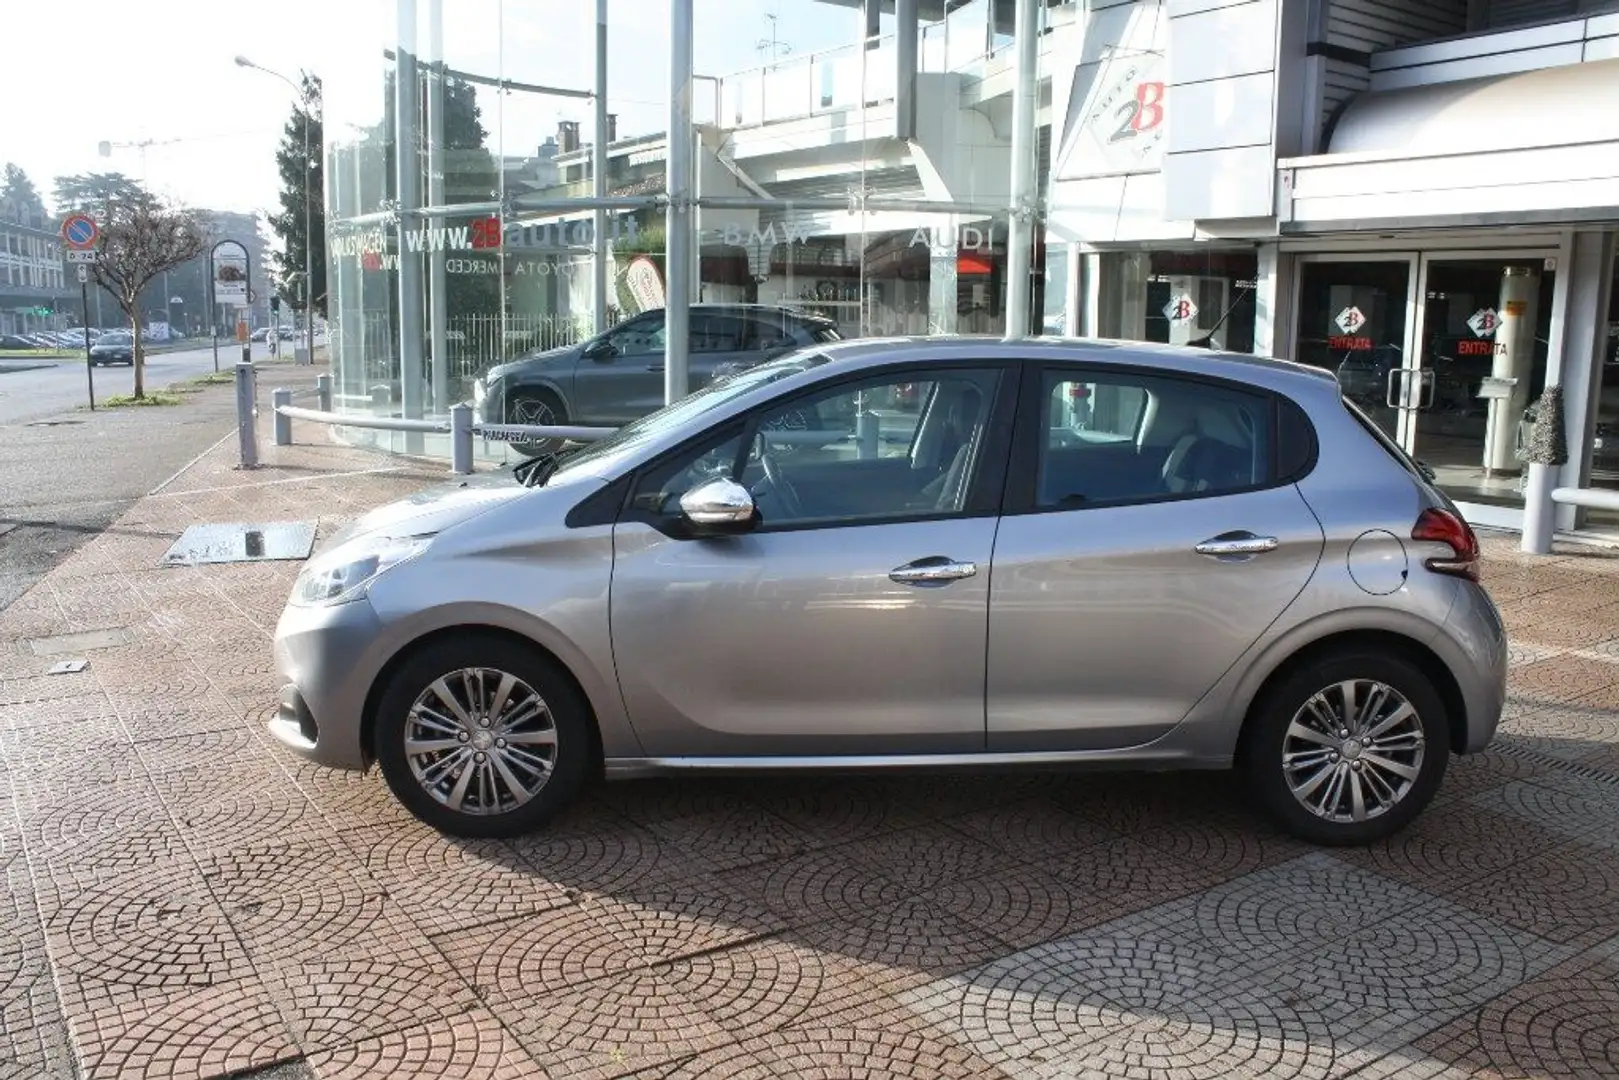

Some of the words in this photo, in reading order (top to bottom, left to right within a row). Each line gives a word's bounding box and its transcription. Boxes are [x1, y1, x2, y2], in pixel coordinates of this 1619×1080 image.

[1106, 81, 1165, 145] 2B
[724, 220, 811, 246] BMW
[908, 224, 993, 250] AUDI
[1171, 298, 1190, 320] 2B
[1343, 312, 1359, 327] 2B
[1477, 313, 1495, 331] 2B
[1328, 336, 1374, 352] ENTRATA
[1457, 340, 1508, 356] ENTRATA
